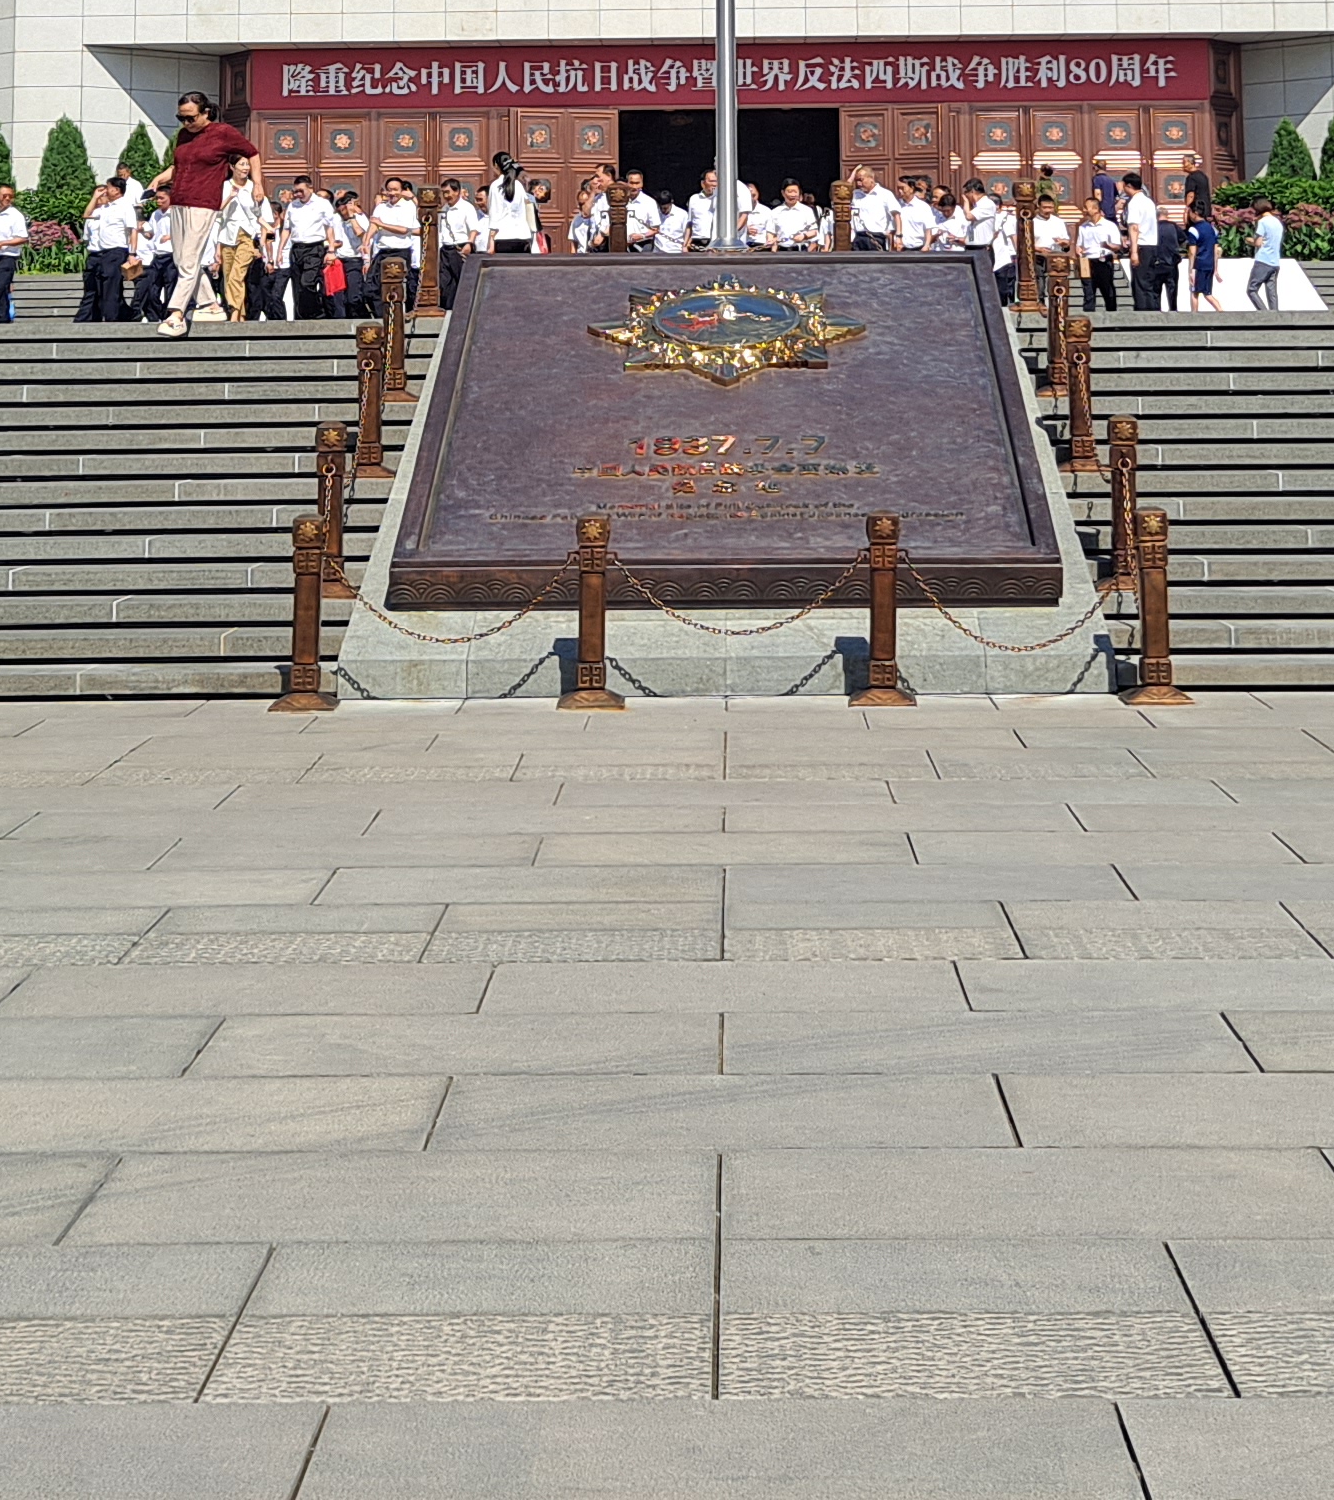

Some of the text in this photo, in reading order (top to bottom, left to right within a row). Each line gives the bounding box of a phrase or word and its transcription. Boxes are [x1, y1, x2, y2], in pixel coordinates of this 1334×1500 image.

[281, 53, 1178, 98] 隆重纪念中国人民抗日战争暨世界反法西斯战争胜利80周年
[627, 435, 826, 456] 1937.7.7
